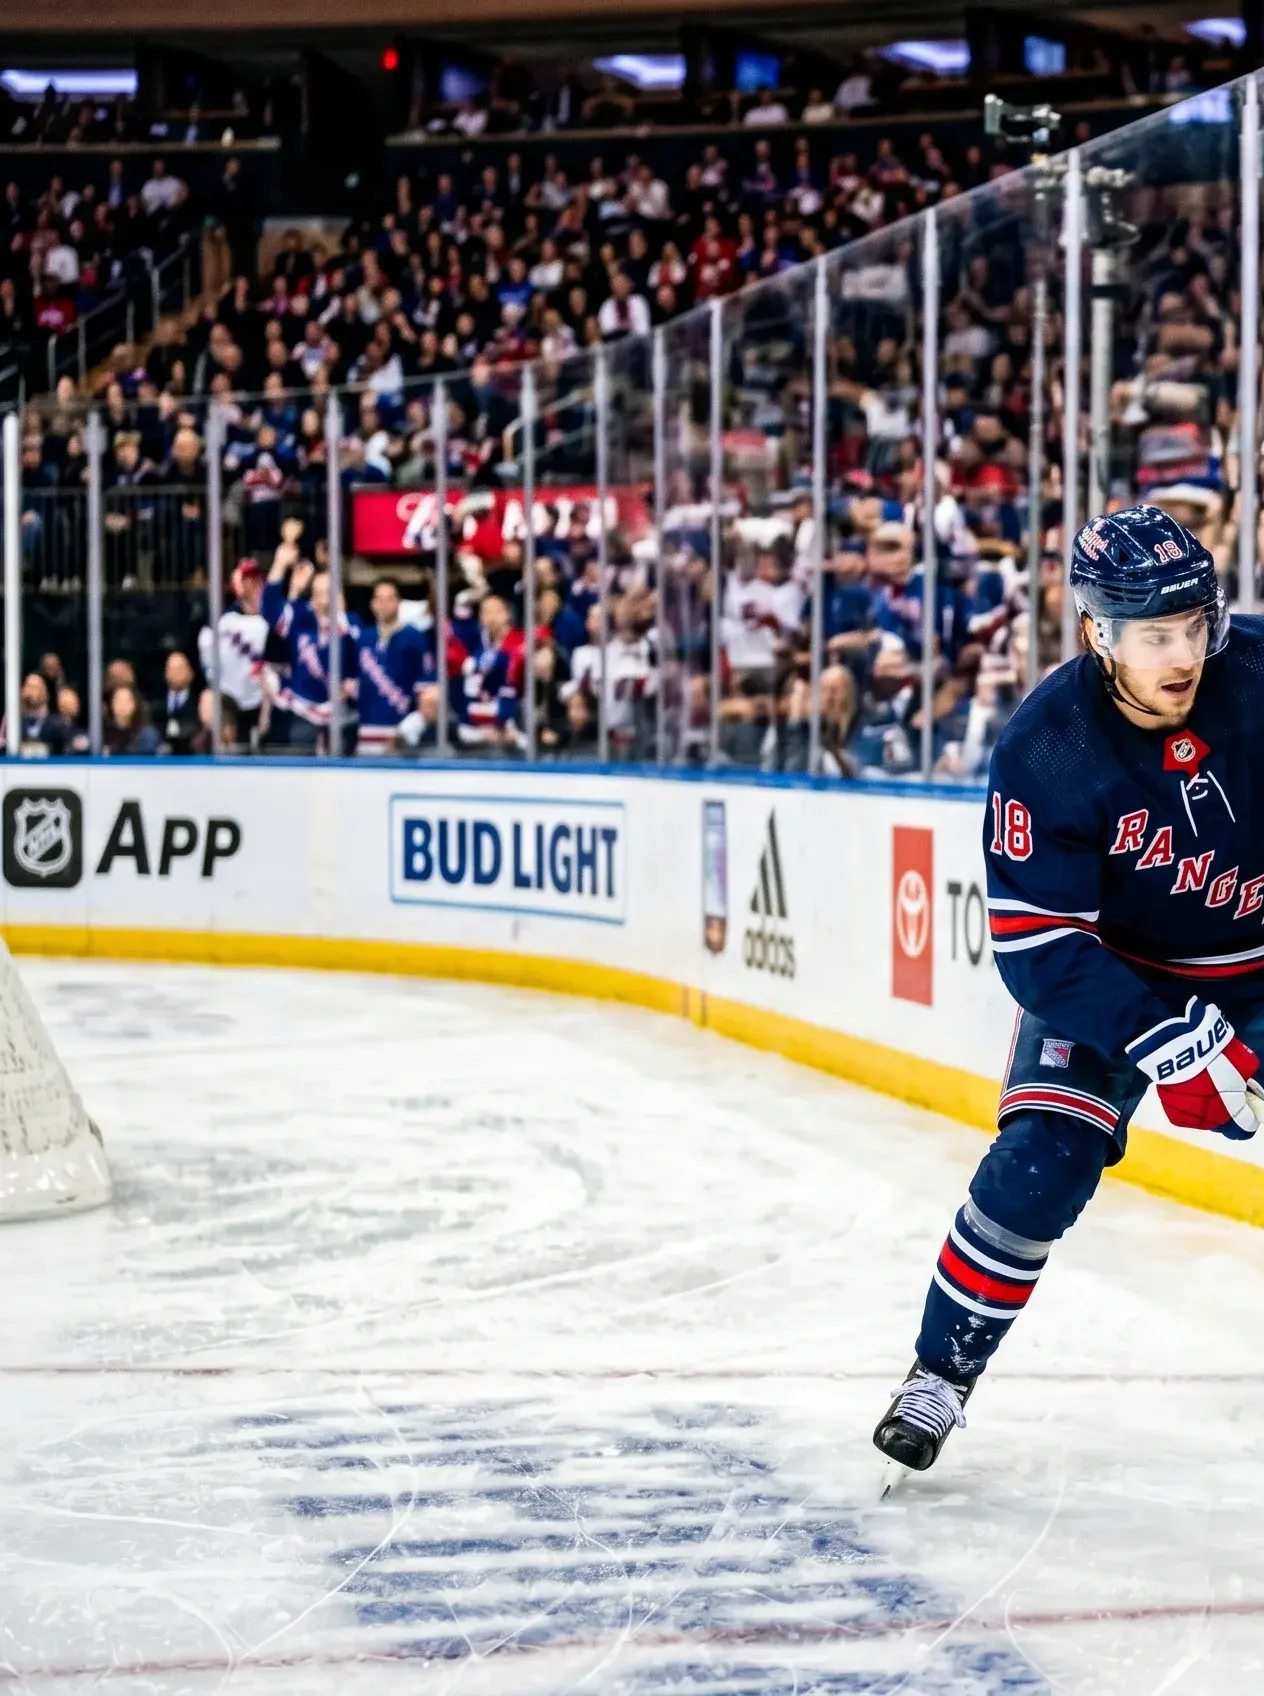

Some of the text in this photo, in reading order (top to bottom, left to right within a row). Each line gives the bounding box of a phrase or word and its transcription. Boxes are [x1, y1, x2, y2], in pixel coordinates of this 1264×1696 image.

[403, 818, 618, 898] BUD LIGHT
[990, 791, 1034, 861] 18
[947, 880, 988, 967] TO
